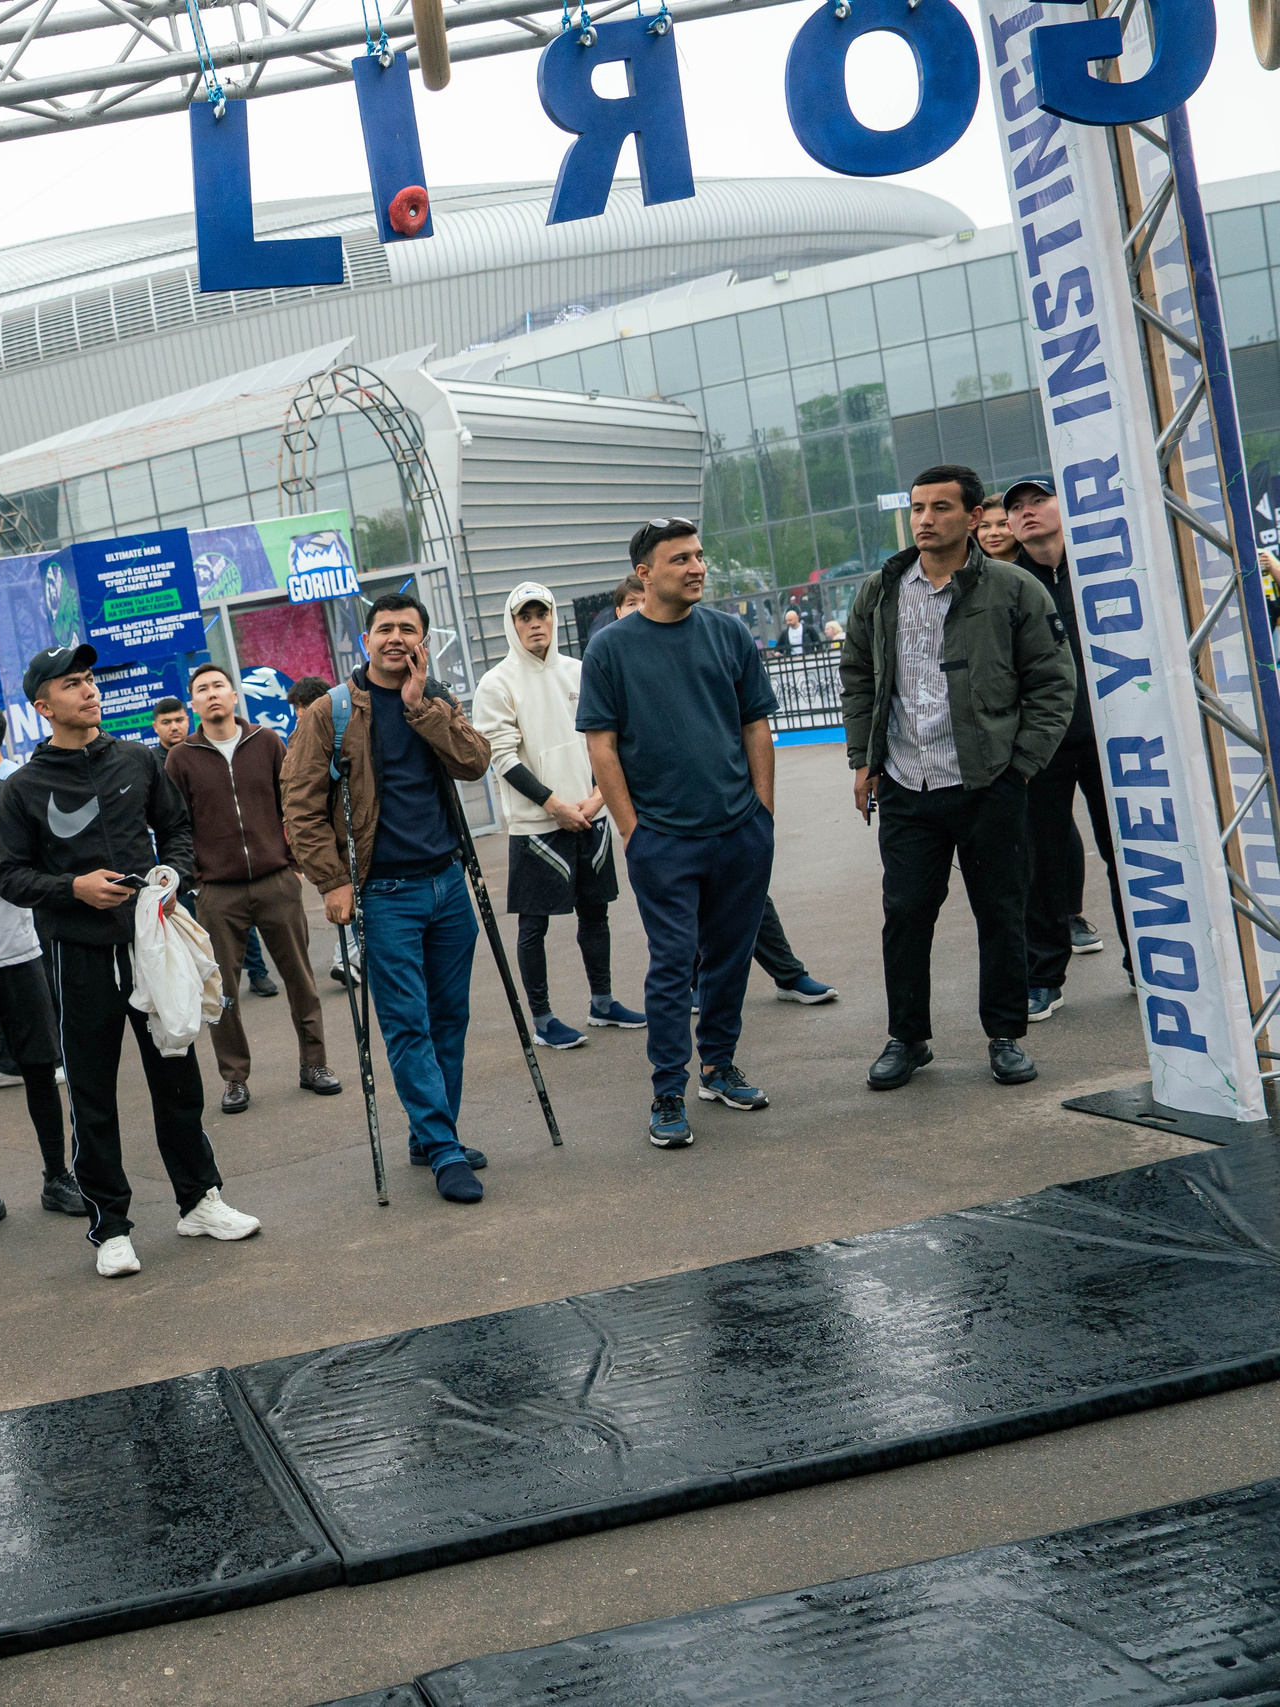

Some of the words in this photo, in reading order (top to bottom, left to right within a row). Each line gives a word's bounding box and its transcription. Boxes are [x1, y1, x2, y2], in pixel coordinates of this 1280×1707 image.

[105, 549, 142, 563] ULTIMATE
[144, 545, 162, 557] MAN
[116, 583, 147, 594] ULTIMATE
[148, 579, 163, 590] MAN
[289, 568, 360, 602] GORILLA
[1063, 452, 1152, 699] YOUR
[130, 666, 148, 677] MAN
[1107, 735, 1207, 1054] POWER
